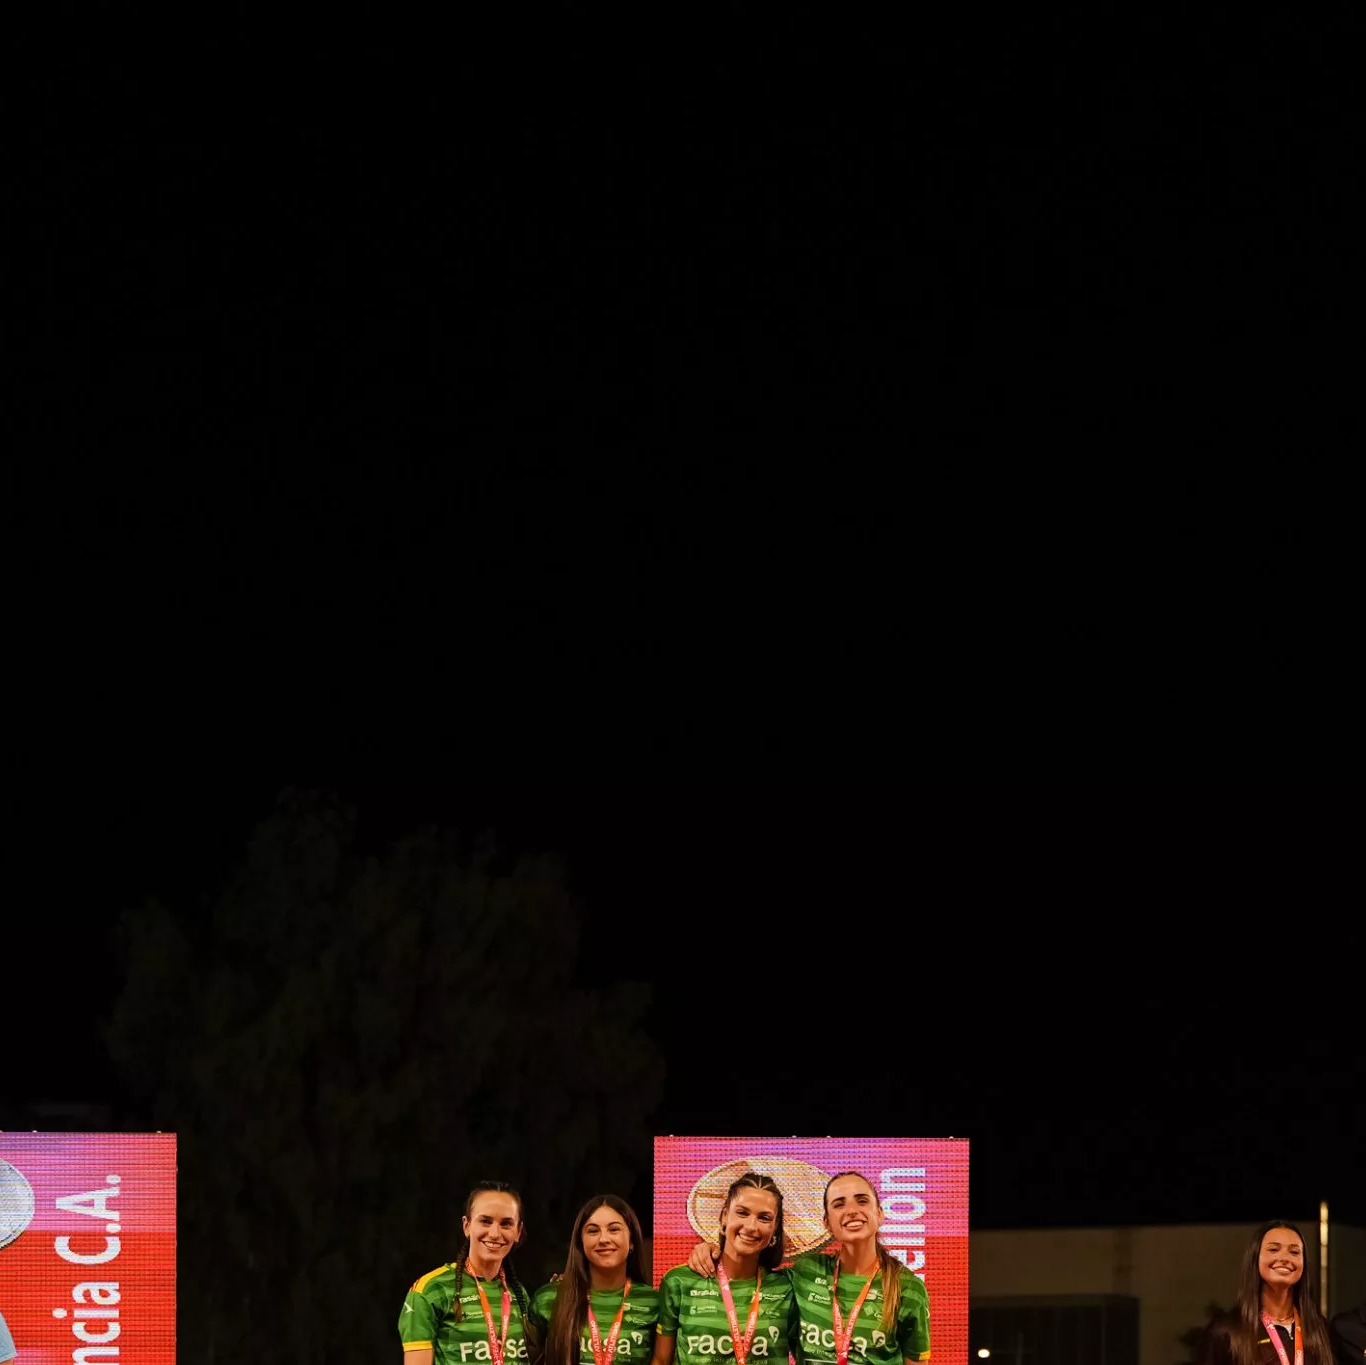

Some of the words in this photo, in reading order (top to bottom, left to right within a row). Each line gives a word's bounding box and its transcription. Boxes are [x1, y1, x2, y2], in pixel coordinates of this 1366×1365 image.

[53, 1174, 121, 1266] C.A.
[460, 1338, 528, 1362] Fasa
[687, 1334, 768, 1356] Faca
